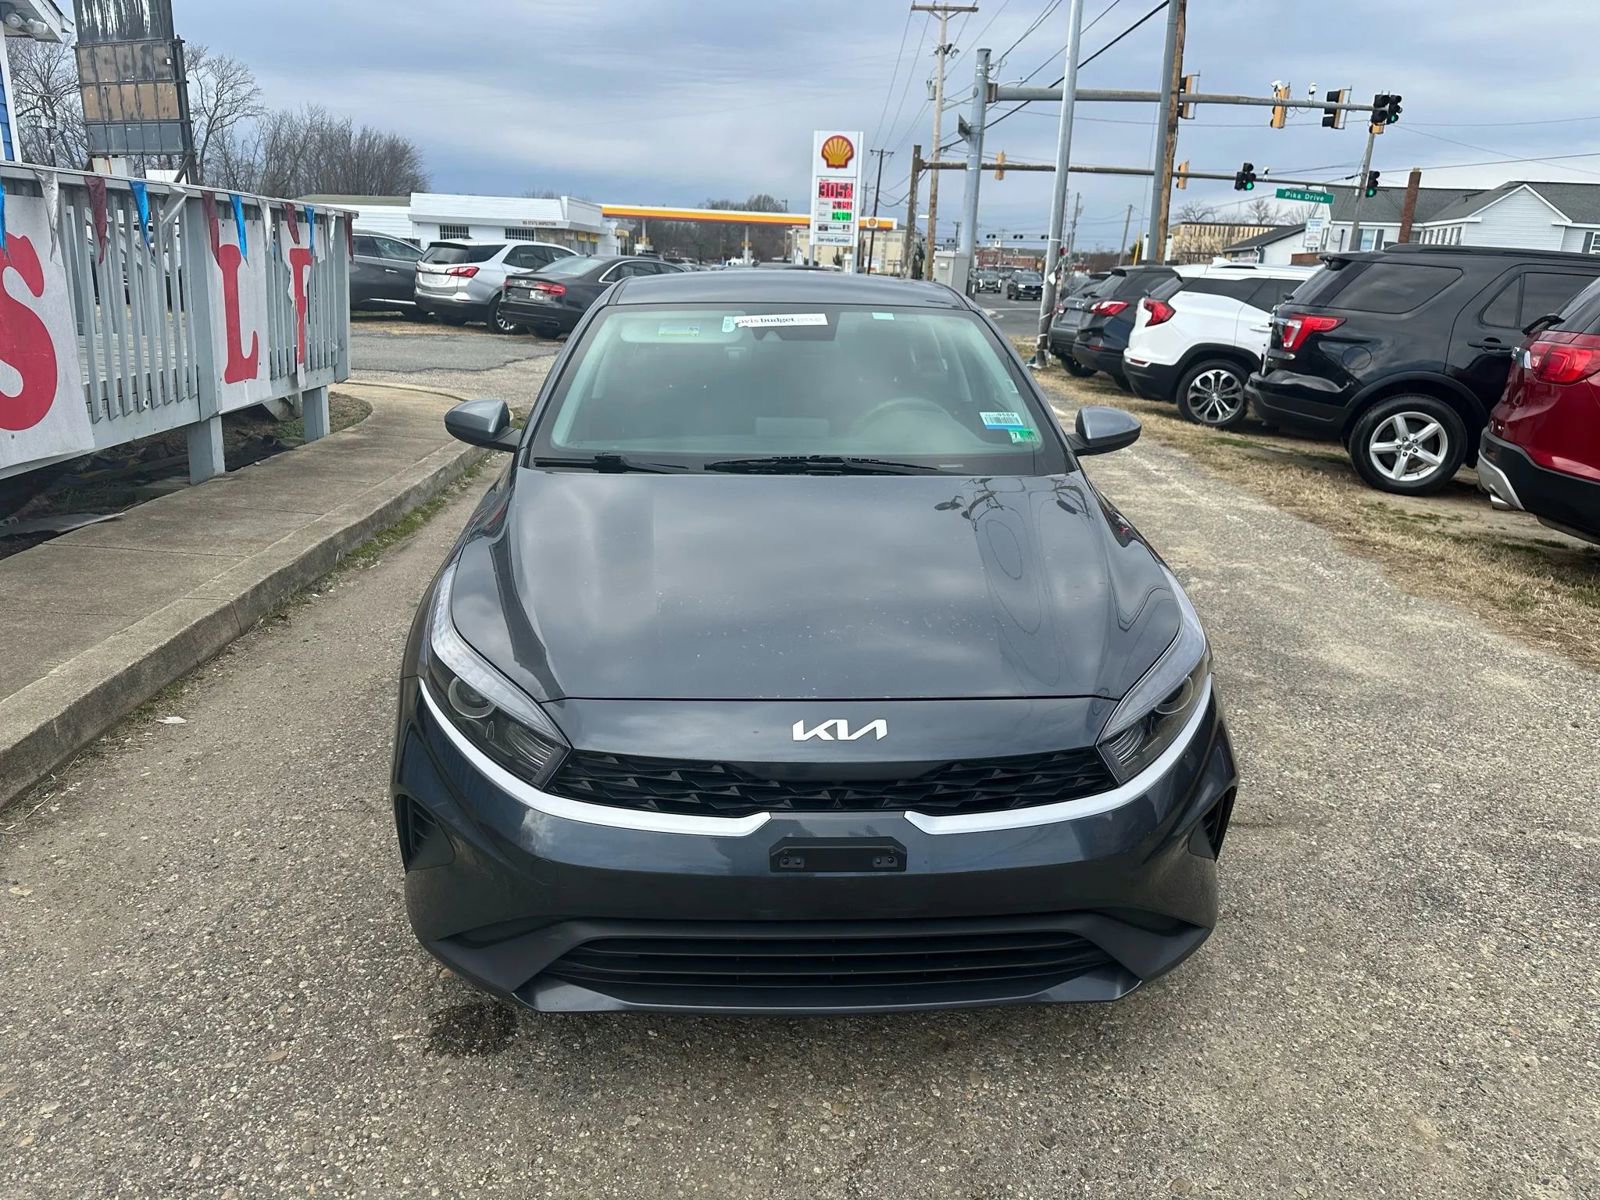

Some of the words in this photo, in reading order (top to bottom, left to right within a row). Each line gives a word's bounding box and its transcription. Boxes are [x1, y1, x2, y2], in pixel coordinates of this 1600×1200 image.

[1304, 194, 1324, 202] Drive
[218, 243, 259, 384] L
[760, 316, 795, 325] budget
[792, 719, 888, 741] KIA
